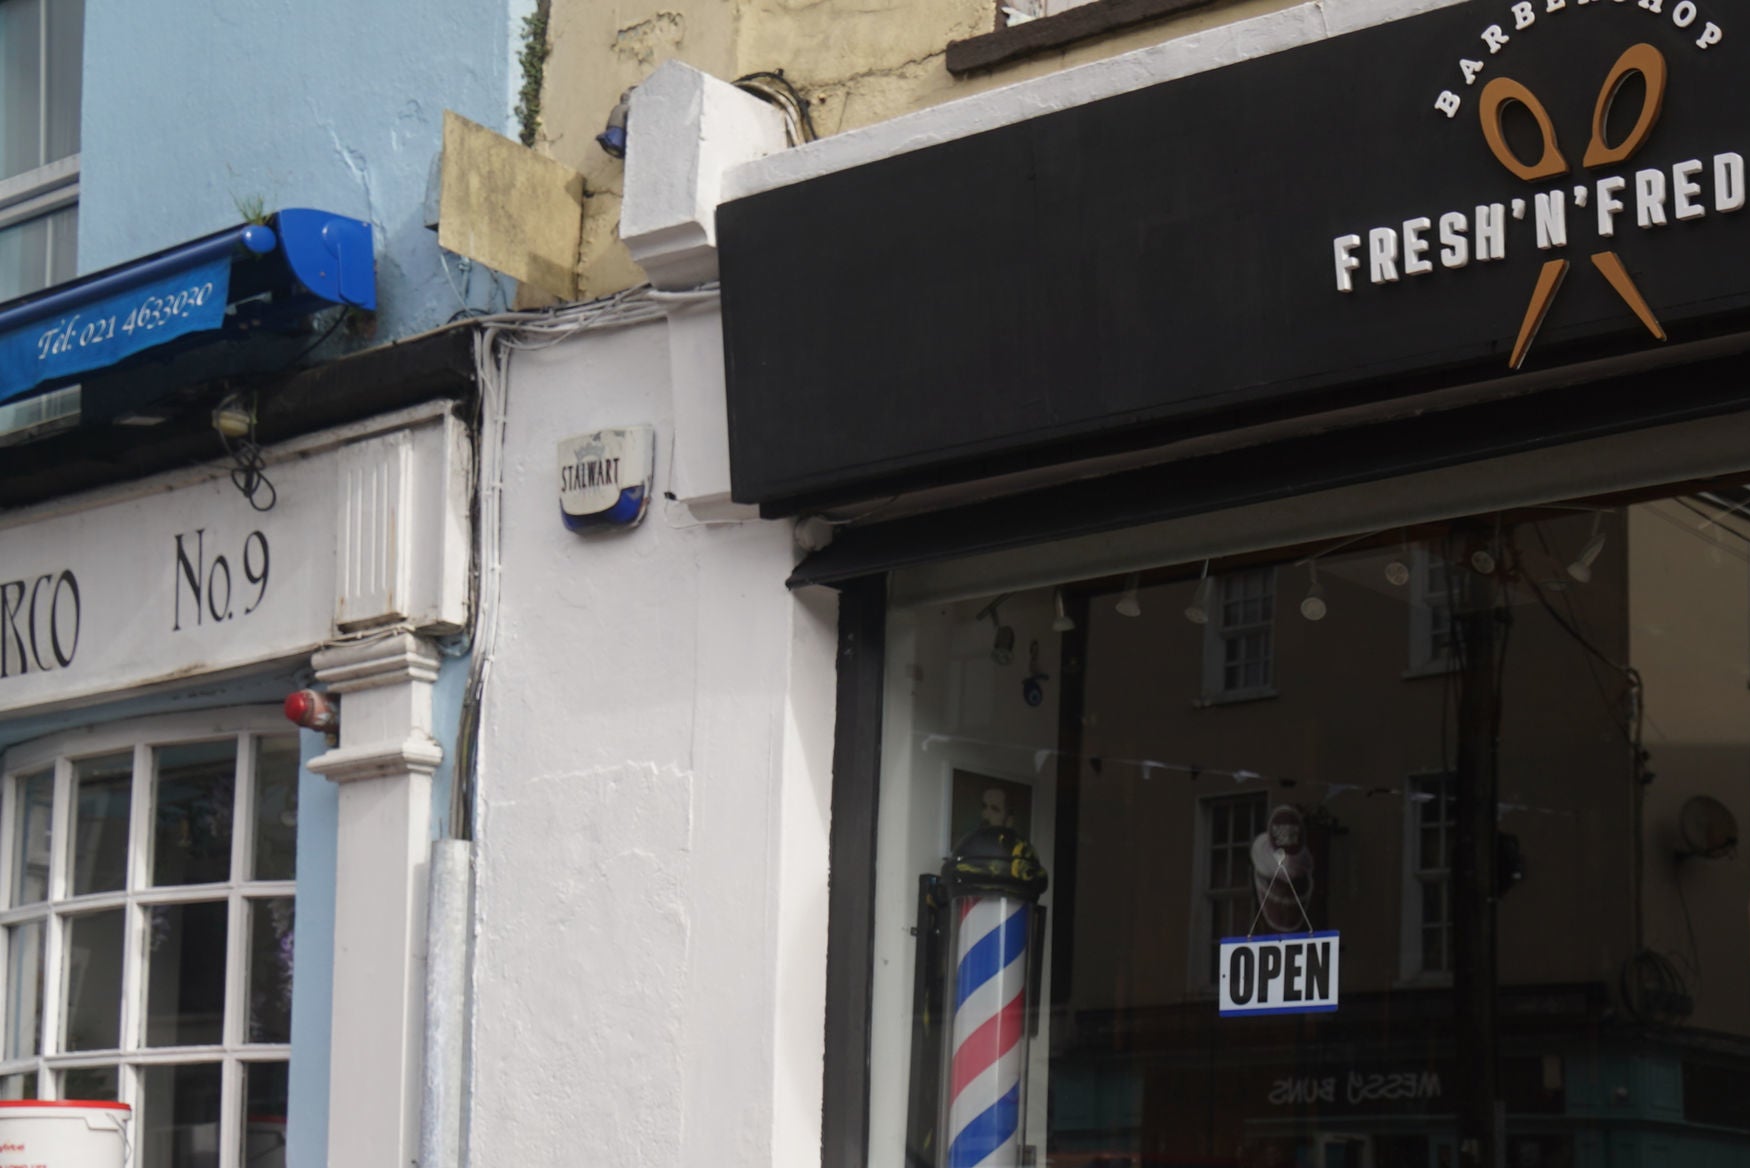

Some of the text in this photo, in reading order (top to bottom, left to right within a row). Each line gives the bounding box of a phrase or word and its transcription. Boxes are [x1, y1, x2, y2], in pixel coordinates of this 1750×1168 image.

[79, 315, 116, 347] 021
[121, 283, 213, 335] 4633030
[561, 457, 620, 492] STALWART
[1229, 941, 1331, 1006] OPEN
